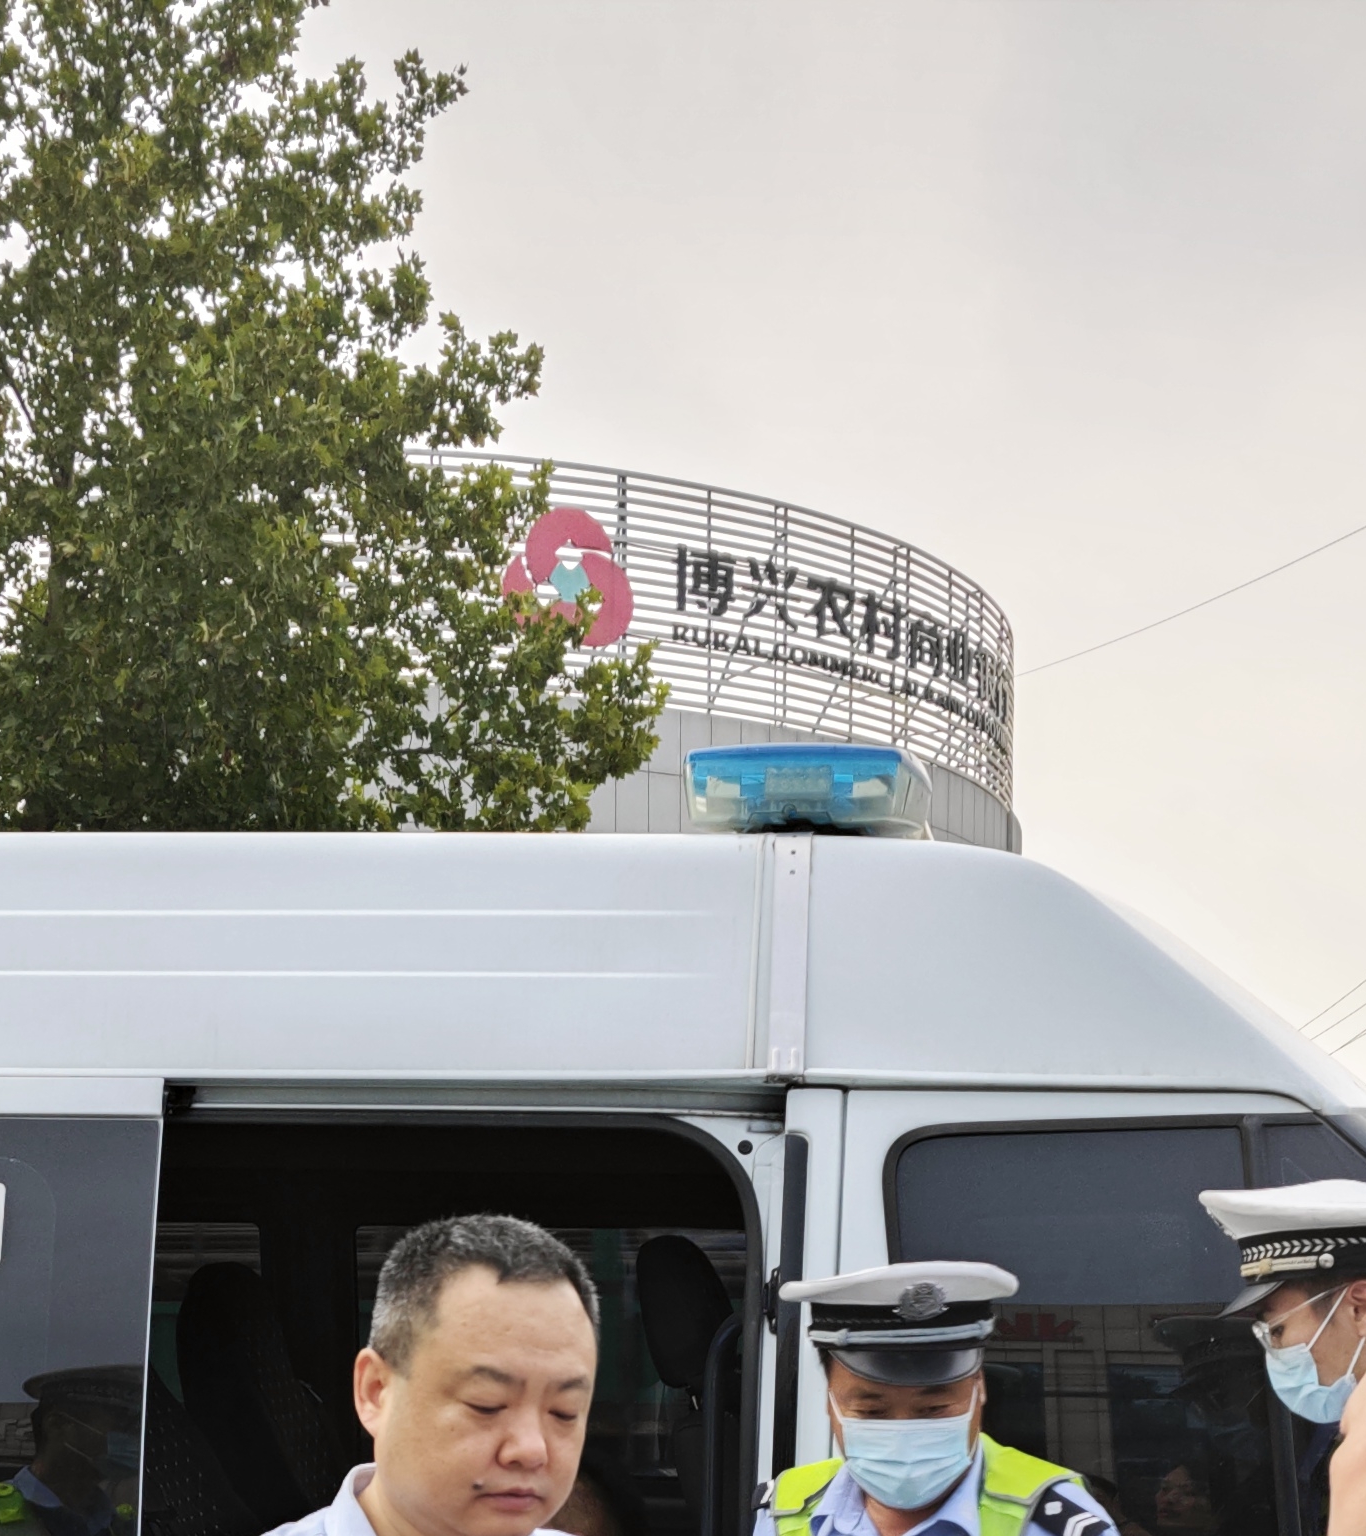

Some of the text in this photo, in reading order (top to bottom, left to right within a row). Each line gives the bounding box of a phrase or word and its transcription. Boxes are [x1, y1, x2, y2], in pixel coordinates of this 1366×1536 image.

[672, 543, 1009, 726] 博兴农村商业银行
[672, 623, 772, 660] RURAL
